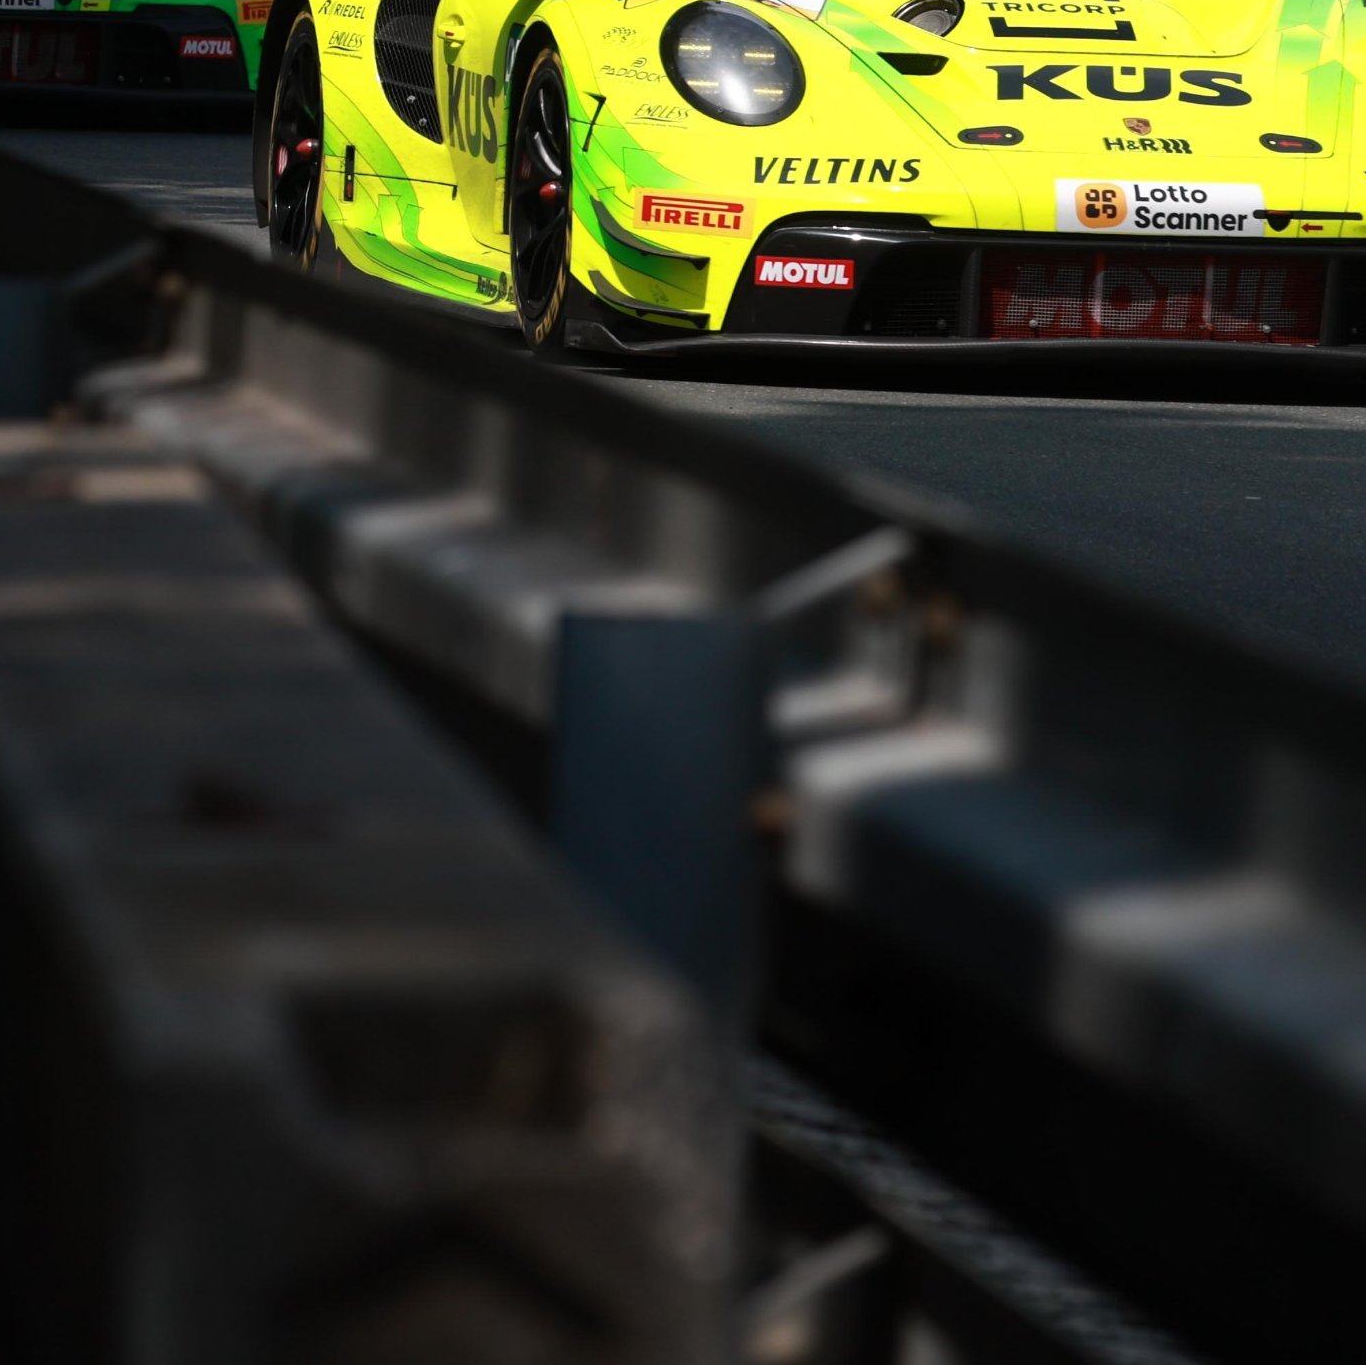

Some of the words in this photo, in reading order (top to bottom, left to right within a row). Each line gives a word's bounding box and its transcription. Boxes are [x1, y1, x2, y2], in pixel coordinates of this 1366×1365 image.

[334, 3, 366, 20] RIEDEL
[981, 1, 1126, 15] TRICORP
[183, 39, 232, 55] MOTUL
[328, 30, 365, 48] ENDLESS
[600, 65, 668, 82] PADDOCK
[985, 65, 1253, 107] KÜS
[447, 64, 498, 164] KÜS
[635, 103, 691, 119] ENDLESS
[753, 157, 921, 185] VELTINS
[1134, 184, 1208, 203] Lotto
[641, 195, 744, 231] PIRELLI
[1134, 206, 1248, 231] Scanner
[758, 261, 849, 285] MOTUL
[1002, 263, 1297, 331] MOTUL
